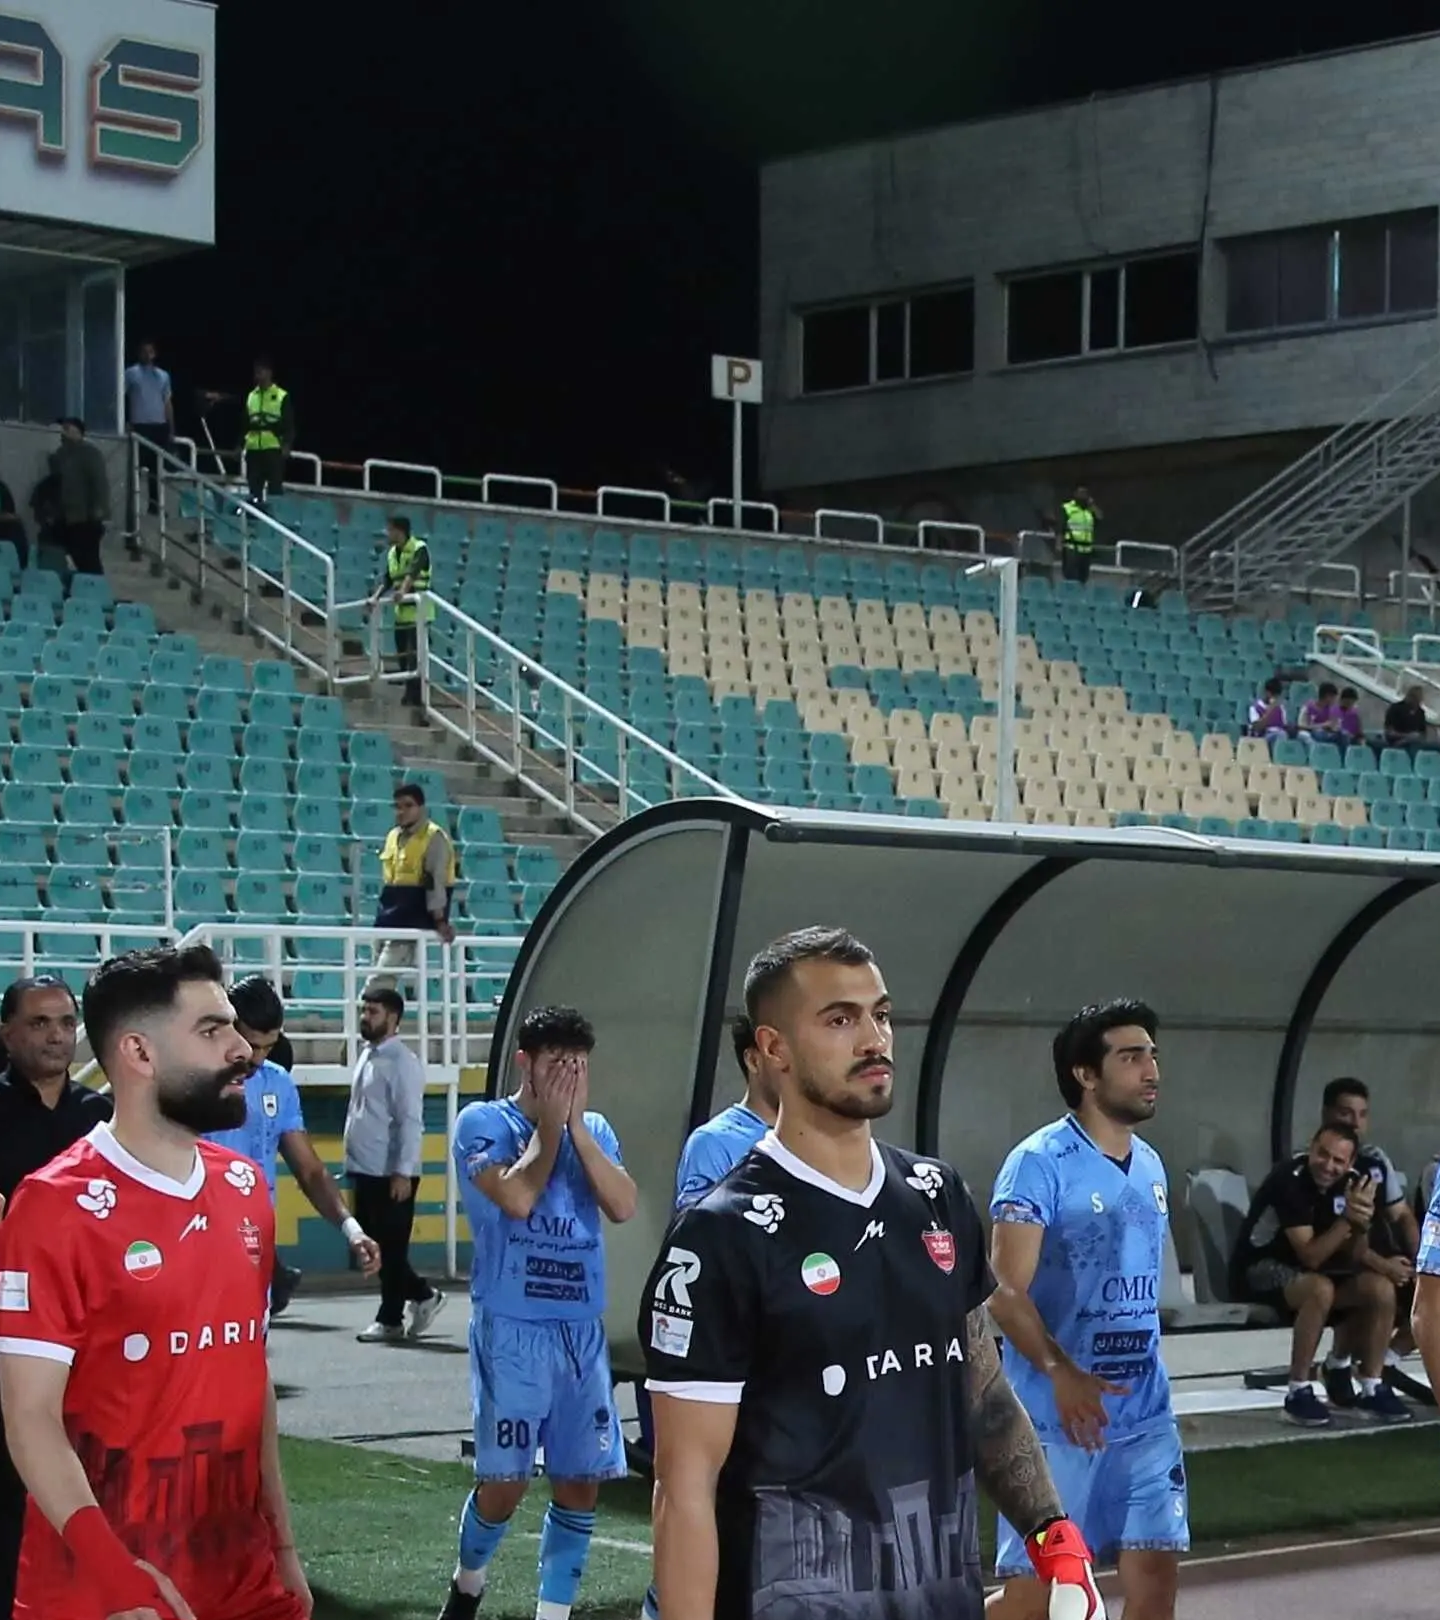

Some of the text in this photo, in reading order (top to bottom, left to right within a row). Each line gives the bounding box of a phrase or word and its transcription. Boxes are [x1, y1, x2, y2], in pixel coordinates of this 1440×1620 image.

[727, 360, 752, 398] P
[1102, 1275, 1157, 1302] CMIC
[497, 1418, 530, 1449] 80
